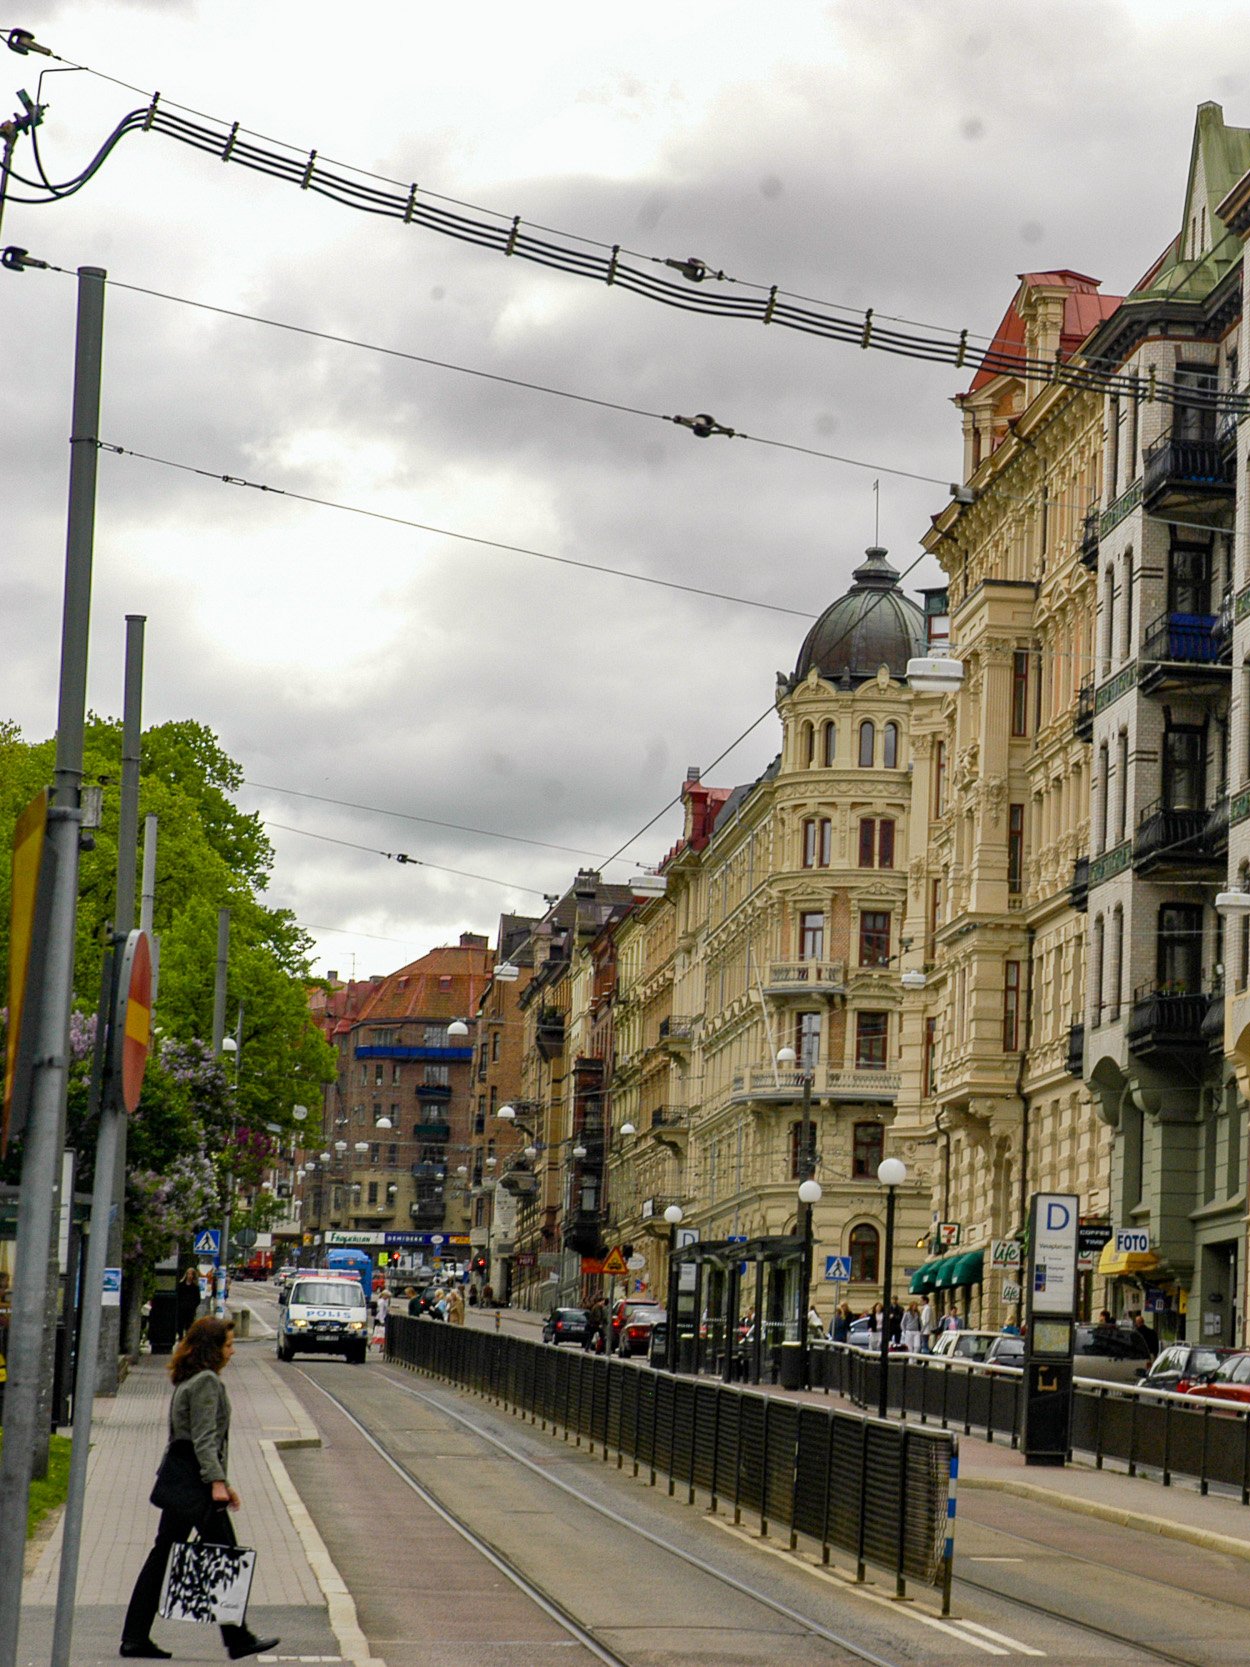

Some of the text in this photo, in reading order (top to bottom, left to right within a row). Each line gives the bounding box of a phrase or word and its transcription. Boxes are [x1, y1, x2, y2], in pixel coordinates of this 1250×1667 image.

[1047, 1202, 1070, 1230] D
[1117, 1235, 1147, 1251] FOTO
[306, 1310, 351, 1320] POLIS
